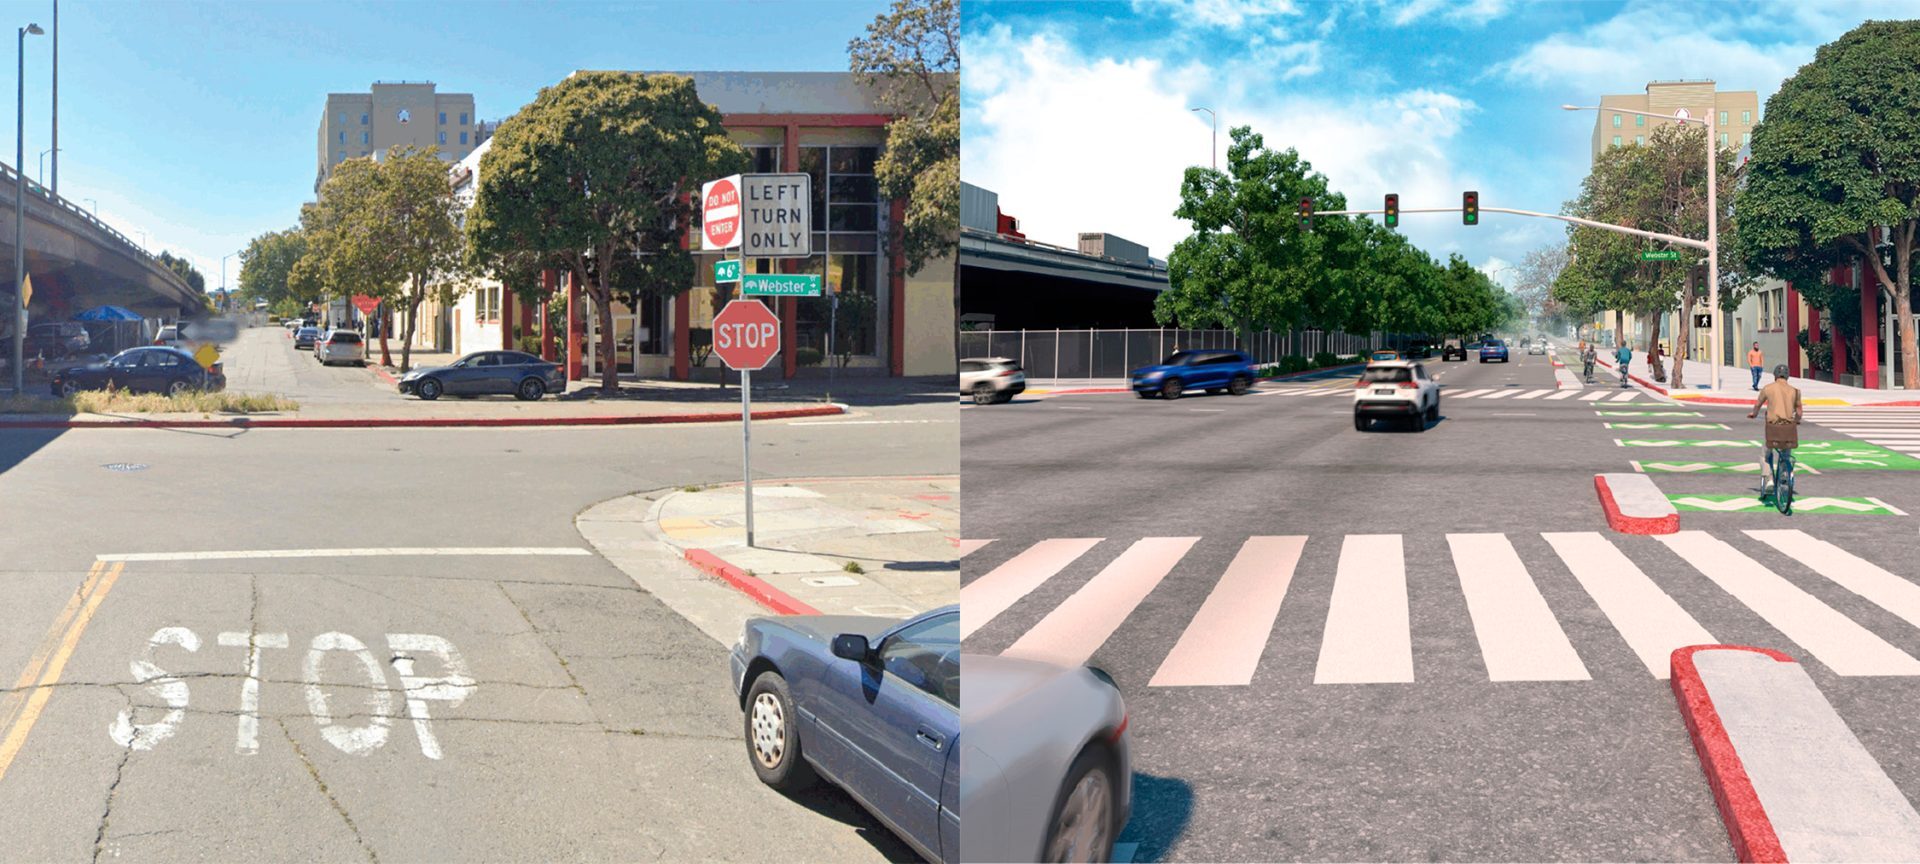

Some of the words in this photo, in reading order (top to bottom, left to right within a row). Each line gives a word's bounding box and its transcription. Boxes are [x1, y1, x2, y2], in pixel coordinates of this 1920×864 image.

[709, 195, 719, 206] DO
[722, 190, 735, 202] NOT
[751, 185, 800, 200] LEFT
[751, 208, 801, 224] TURN
[711, 222, 734, 236] ENTER
[751, 232, 801, 248] ONLY
[758, 279, 805, 292] Webster
[718, 323, 775, 349] STOP
[109, 626, 478, 761] STOP
